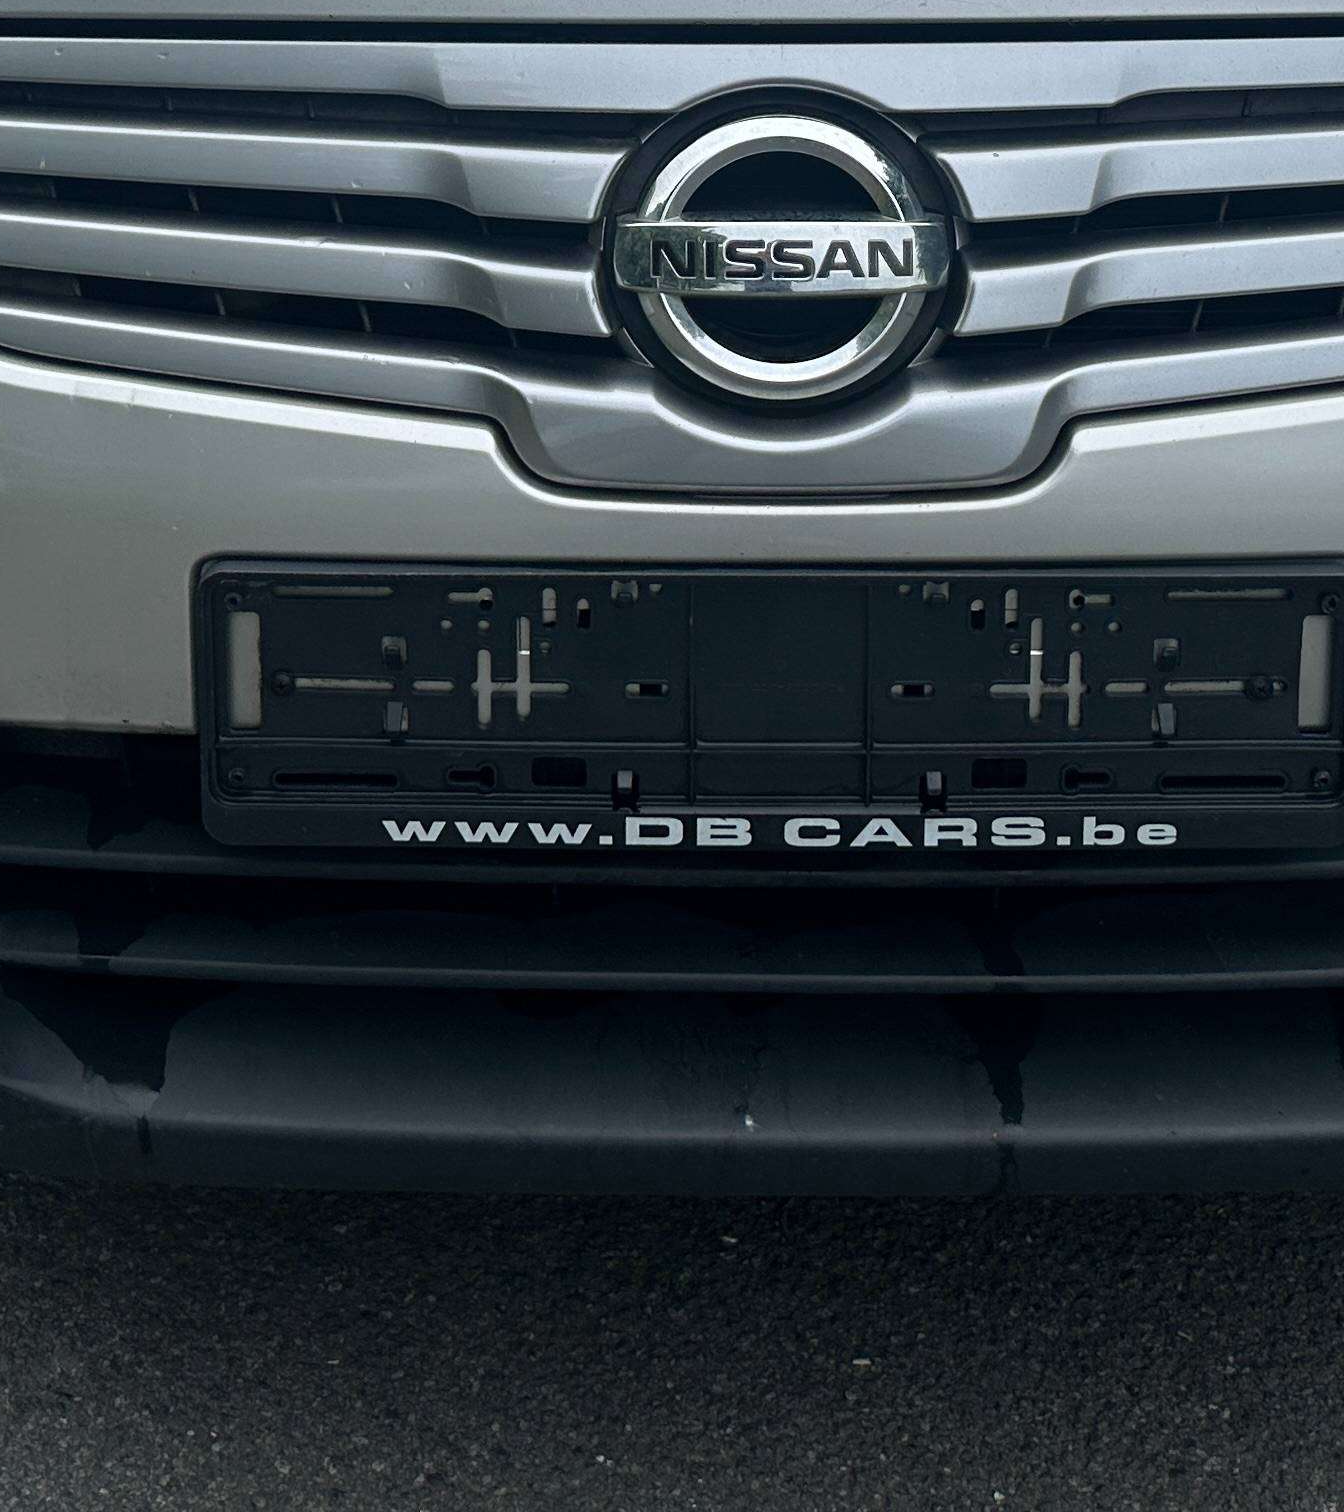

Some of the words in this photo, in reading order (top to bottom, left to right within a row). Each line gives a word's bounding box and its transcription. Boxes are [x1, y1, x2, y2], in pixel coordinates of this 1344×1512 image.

[649, 239, 915, 281] NISSAN
[381, 815, 752, 848] www.DB
[783, 815, 1178, 848] CARS.be
